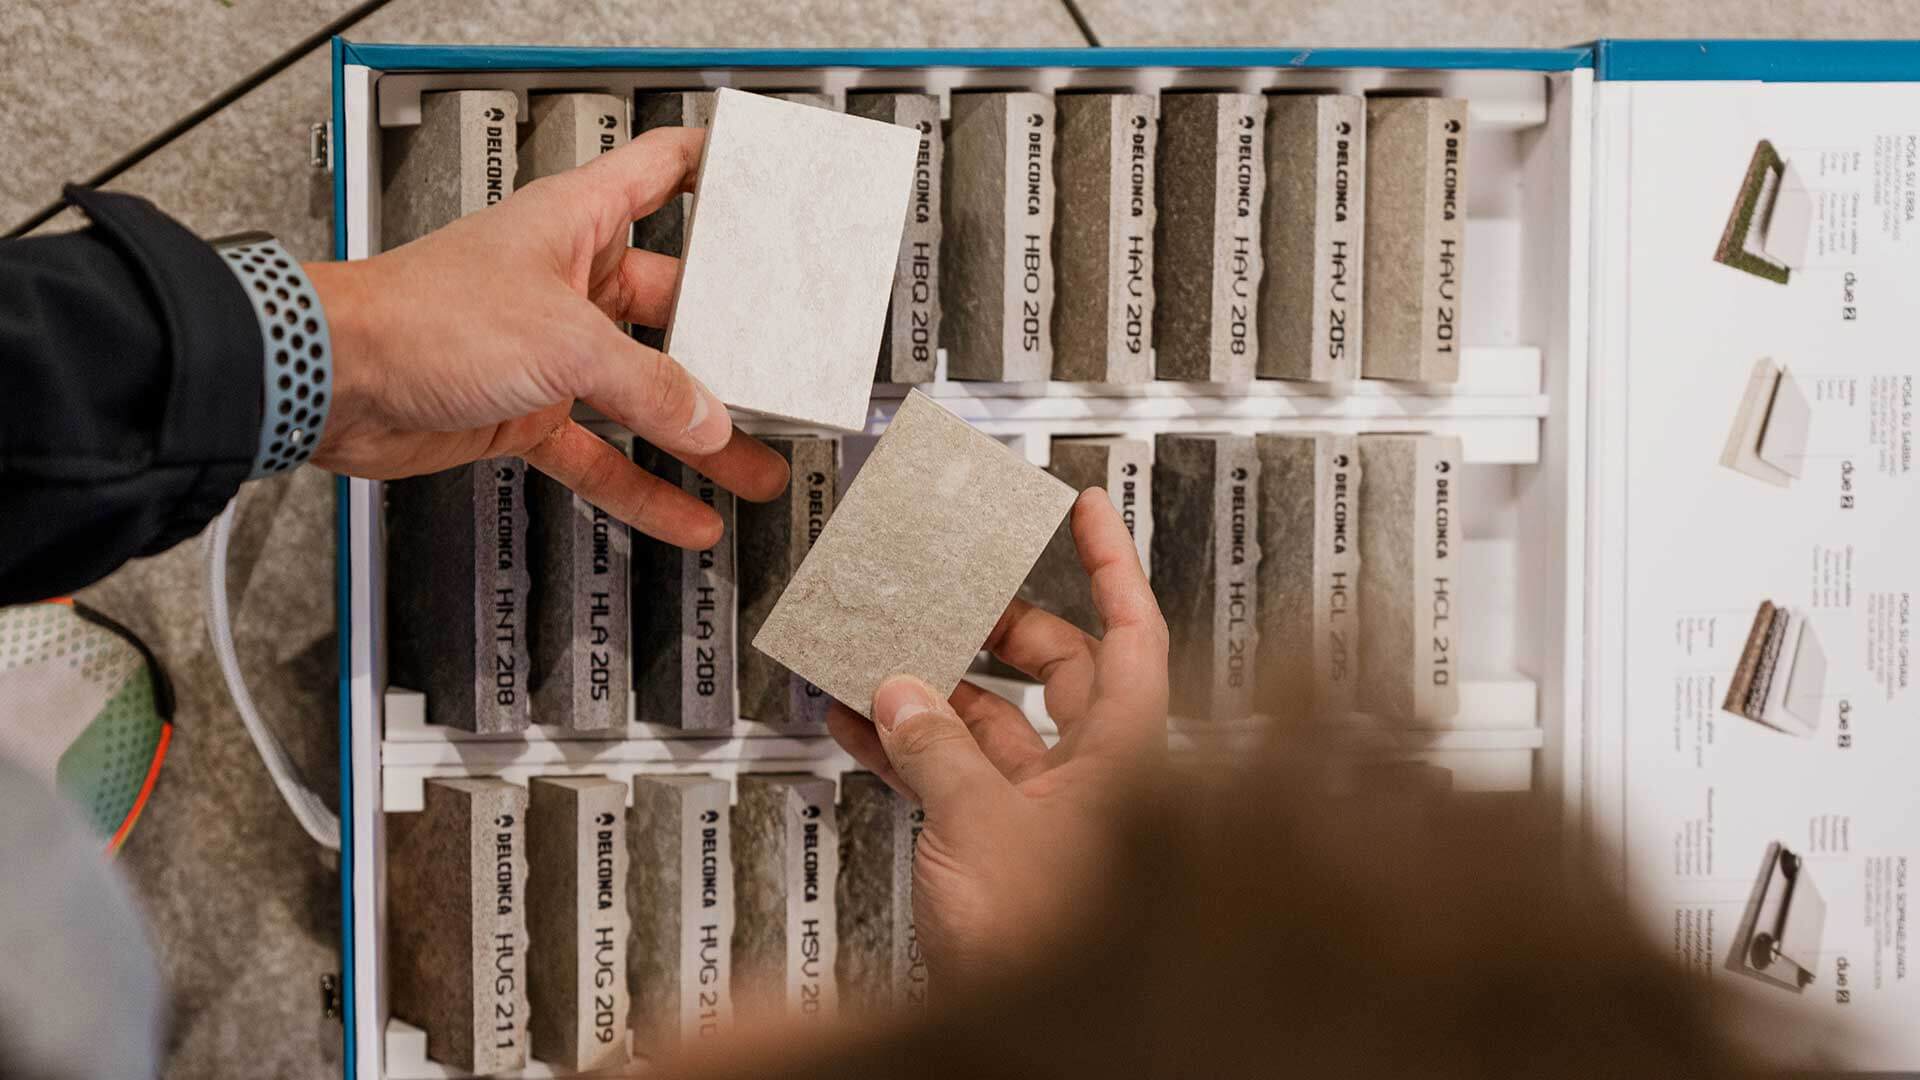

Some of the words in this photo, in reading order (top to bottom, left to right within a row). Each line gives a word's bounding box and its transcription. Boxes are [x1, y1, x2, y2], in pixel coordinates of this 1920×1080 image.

[1027, 132, 1043, 216] DELCONCA
[1131, 134, 1145, 218] DELCONCA
[1237, 134, 1252, 218] DELCONCA
[1906, 136, 1917, 168] POSA
[916, 140, 931, 223] DELCONCA
[1335, 140, 1349, 223] DELCONCA
[1443, 138, 1457, 221] DELCONCA
[1906, 171, 1915, 187] SU
[1905, 191, 1915, 221] ERBA
[912, 243, 929, 303] HBQ
[1844, 272, 1857, 302] due
[912, 311, 928, 363] 208
[1023, 300, 1039, 352] 205
[1126, 303, 1142, 355] 209
[1231, 305, 1247, 356] 208
[1329, 309, 1346, 360] 205
[1437, 307, 1454, 354] 201
[1902, 376, 1912, 407] POSA
[1902, 412, 1911, 427] SU
[1841, 461, 1854, 491] due
[1902, 430, 1911, 472] SABBIA
[498, 486, 512, 570] DELCONCA
[1233, 485, 1246, 565] DELCONCA
[1334, 473, 1347, 554] DELCONCA
[1435, 479, 1449, 560] DELCONCA
[593, 505, 609, 575] ELCONCA
[497, 589, 514, 647] HNT
[591, 593, 608, 645] HLA
[697, 587, 714, 640] HLA
[1229, 581, 1245, 633] HCL
[1331, 572, 1347, 623] HCL
[1433, 577, 1449, 629] HCL
[498, 655, 514, 706] 208
[592, 653, 608, 701] 205
[698, 648, 714, 697] 208
[1433, 636, 1448, 686] 210
[1838, 700, 1852, 730] due
[497, 833, 512, 915] DELCONCA
[598, 831, 613, 910] DELCONCA
[702, 828, 717, 908] DELCONCA
[805, 823, 818, 903] DELCONCA
[1837, 957, 1850, 987] due
[595, 996, 614, 1043] 209
[801, 984, 818, 1015] 20
[496, 1004, 514, 1048] 211
